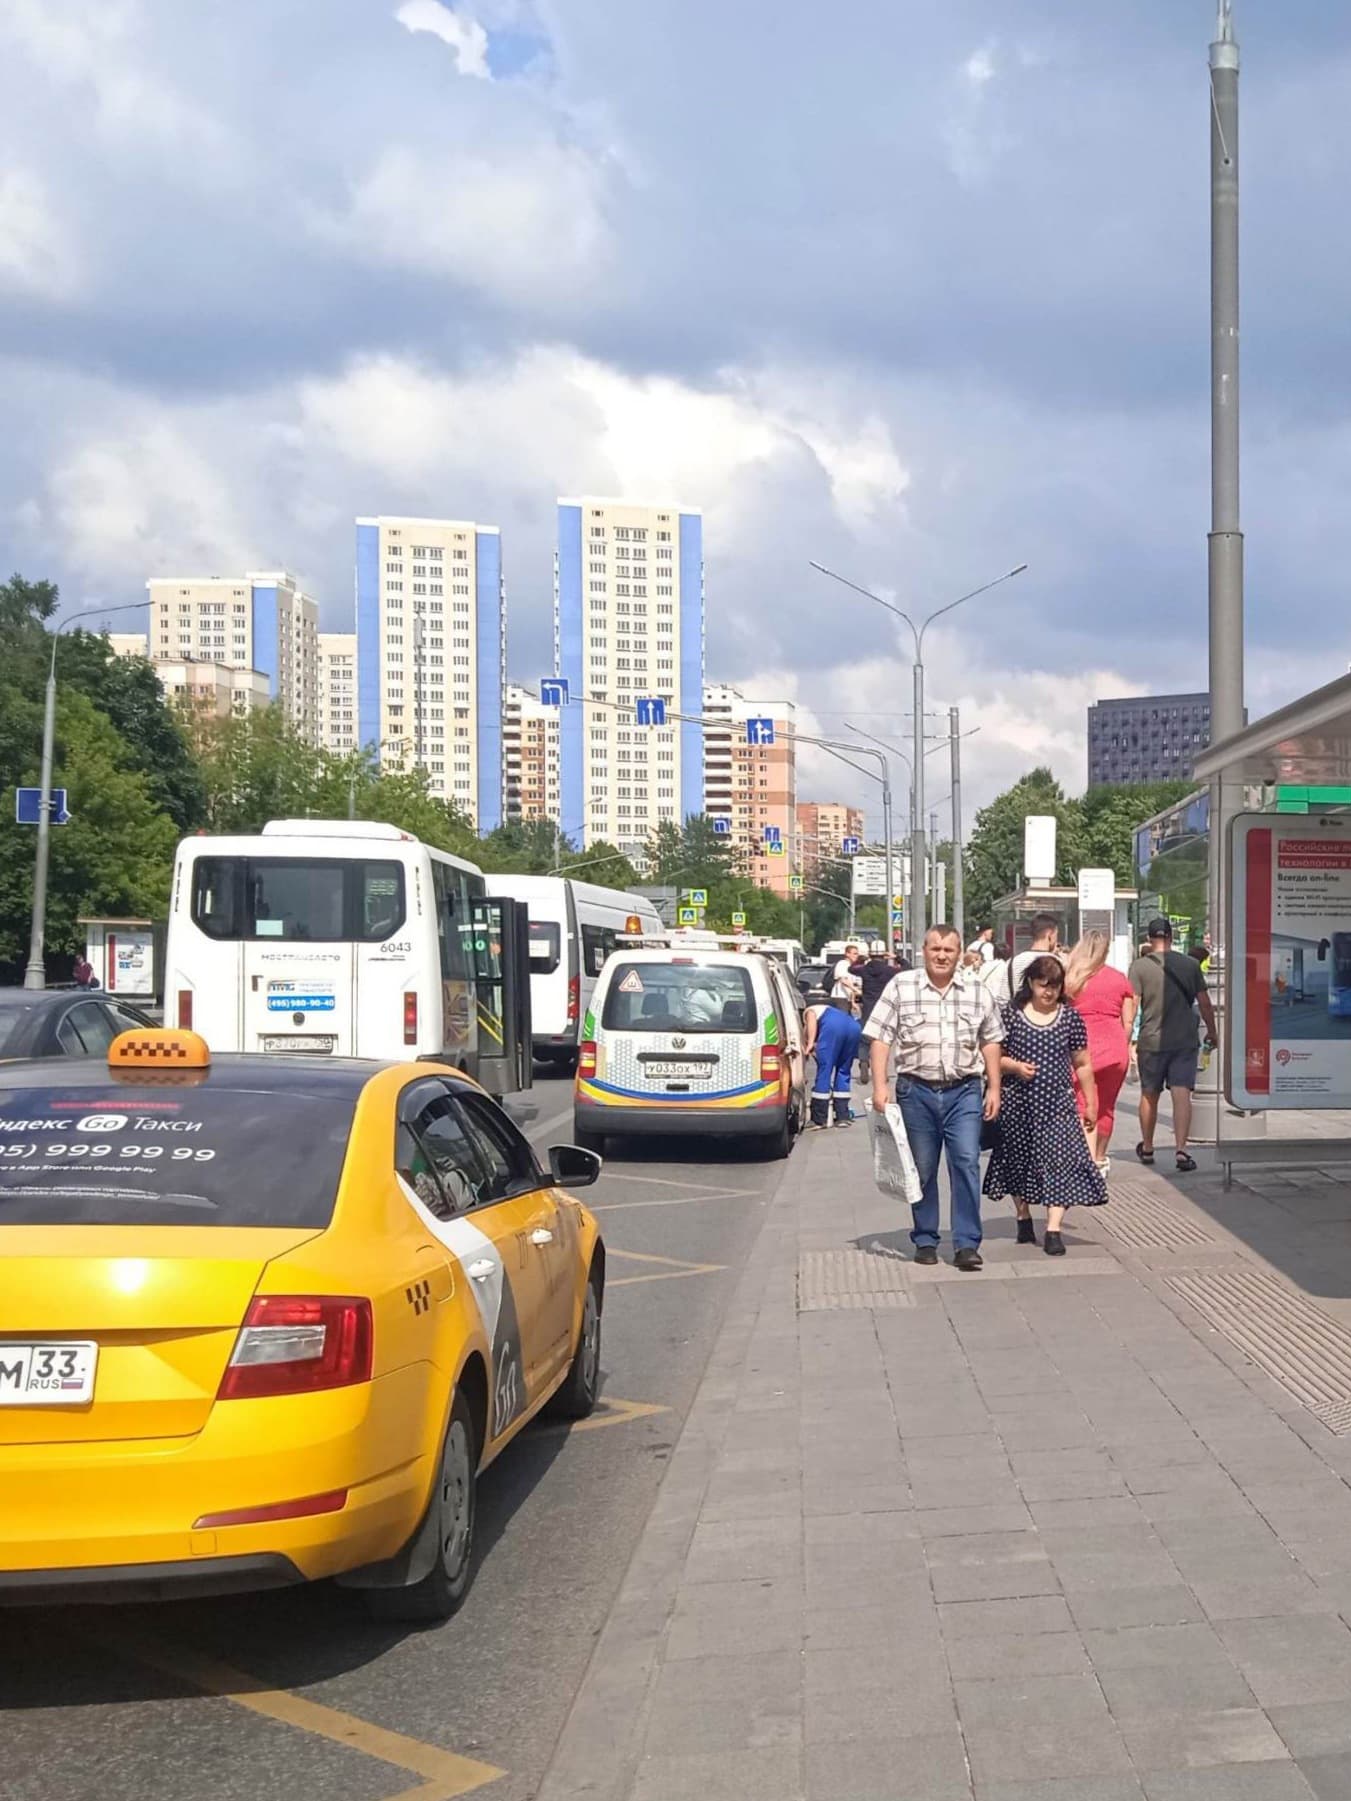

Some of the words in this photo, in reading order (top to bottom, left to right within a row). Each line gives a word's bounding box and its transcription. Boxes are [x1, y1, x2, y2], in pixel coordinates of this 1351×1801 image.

[380, 942, 412, 953] 6043
[0, 1118, 73, 1131] ндекс
[133, 1117, 203, 1132] Такси
[45, 1144, 112, 1157] 999
[119, 1146, 164, 1158] 99
[171, 1148, 215, 1161] 99
[36, 1350, 78, 1378] 33
[29, 1379, 60, 1390] RUS
